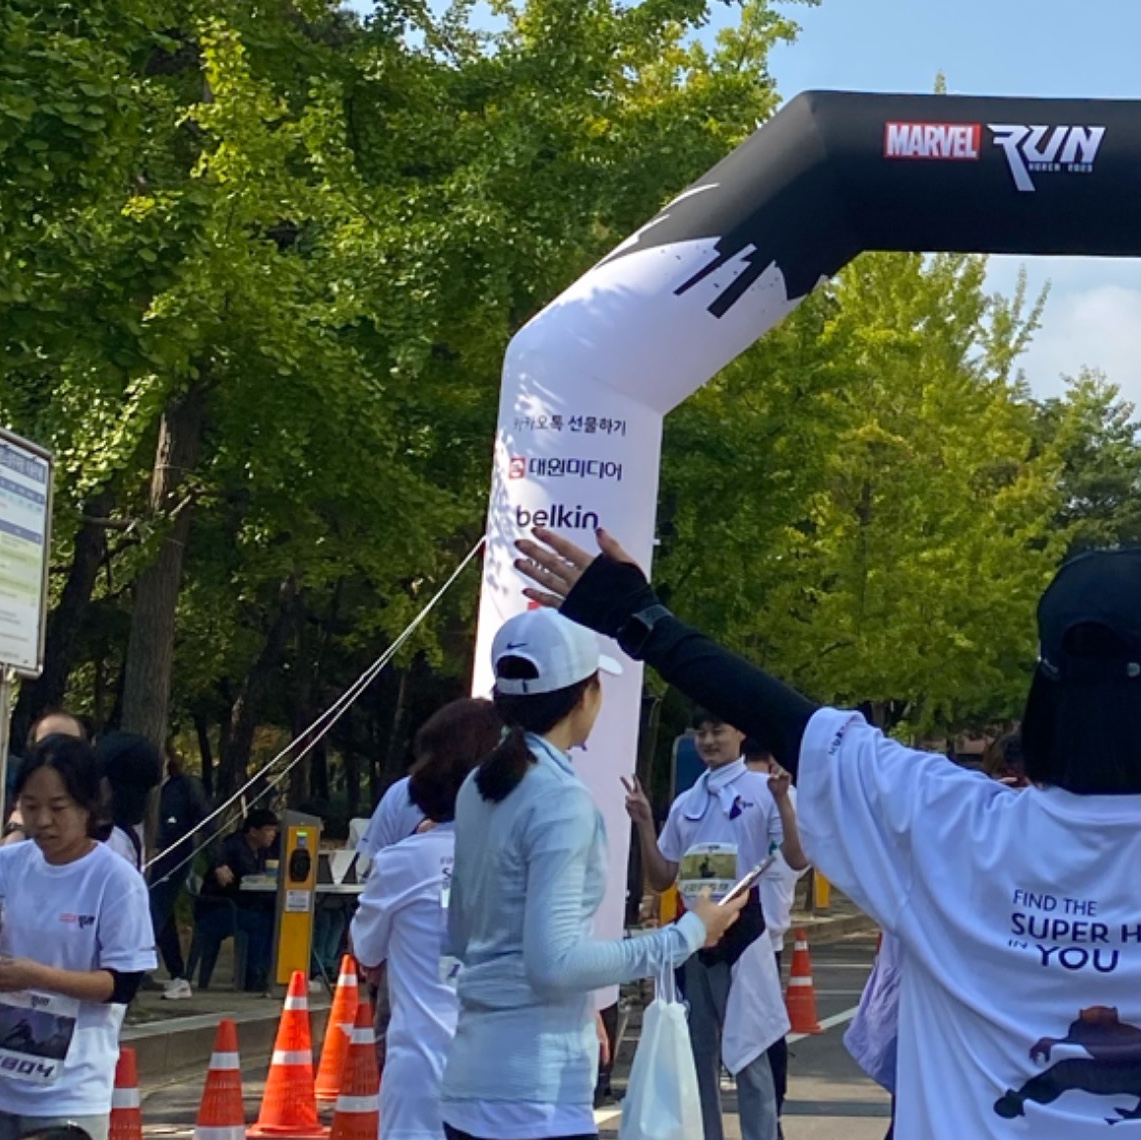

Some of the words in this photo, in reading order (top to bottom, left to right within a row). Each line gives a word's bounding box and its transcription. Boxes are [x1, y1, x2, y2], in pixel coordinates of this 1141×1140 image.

[887, 124, 977, 158] MARVEL
[987, 124, 1106, 191] RUN
[568, 415, 626, 437] 선물하기
[529, 458, 622, 481] 대원미디어
[516, 505, 599, 529] belkin
[1012, 889, 1057, 912] FIND
[1062, 898, 1098, 916] THE
[1011, 912, 1110, 943] SUPER
[1036, 944, 1119, 973] YOU
